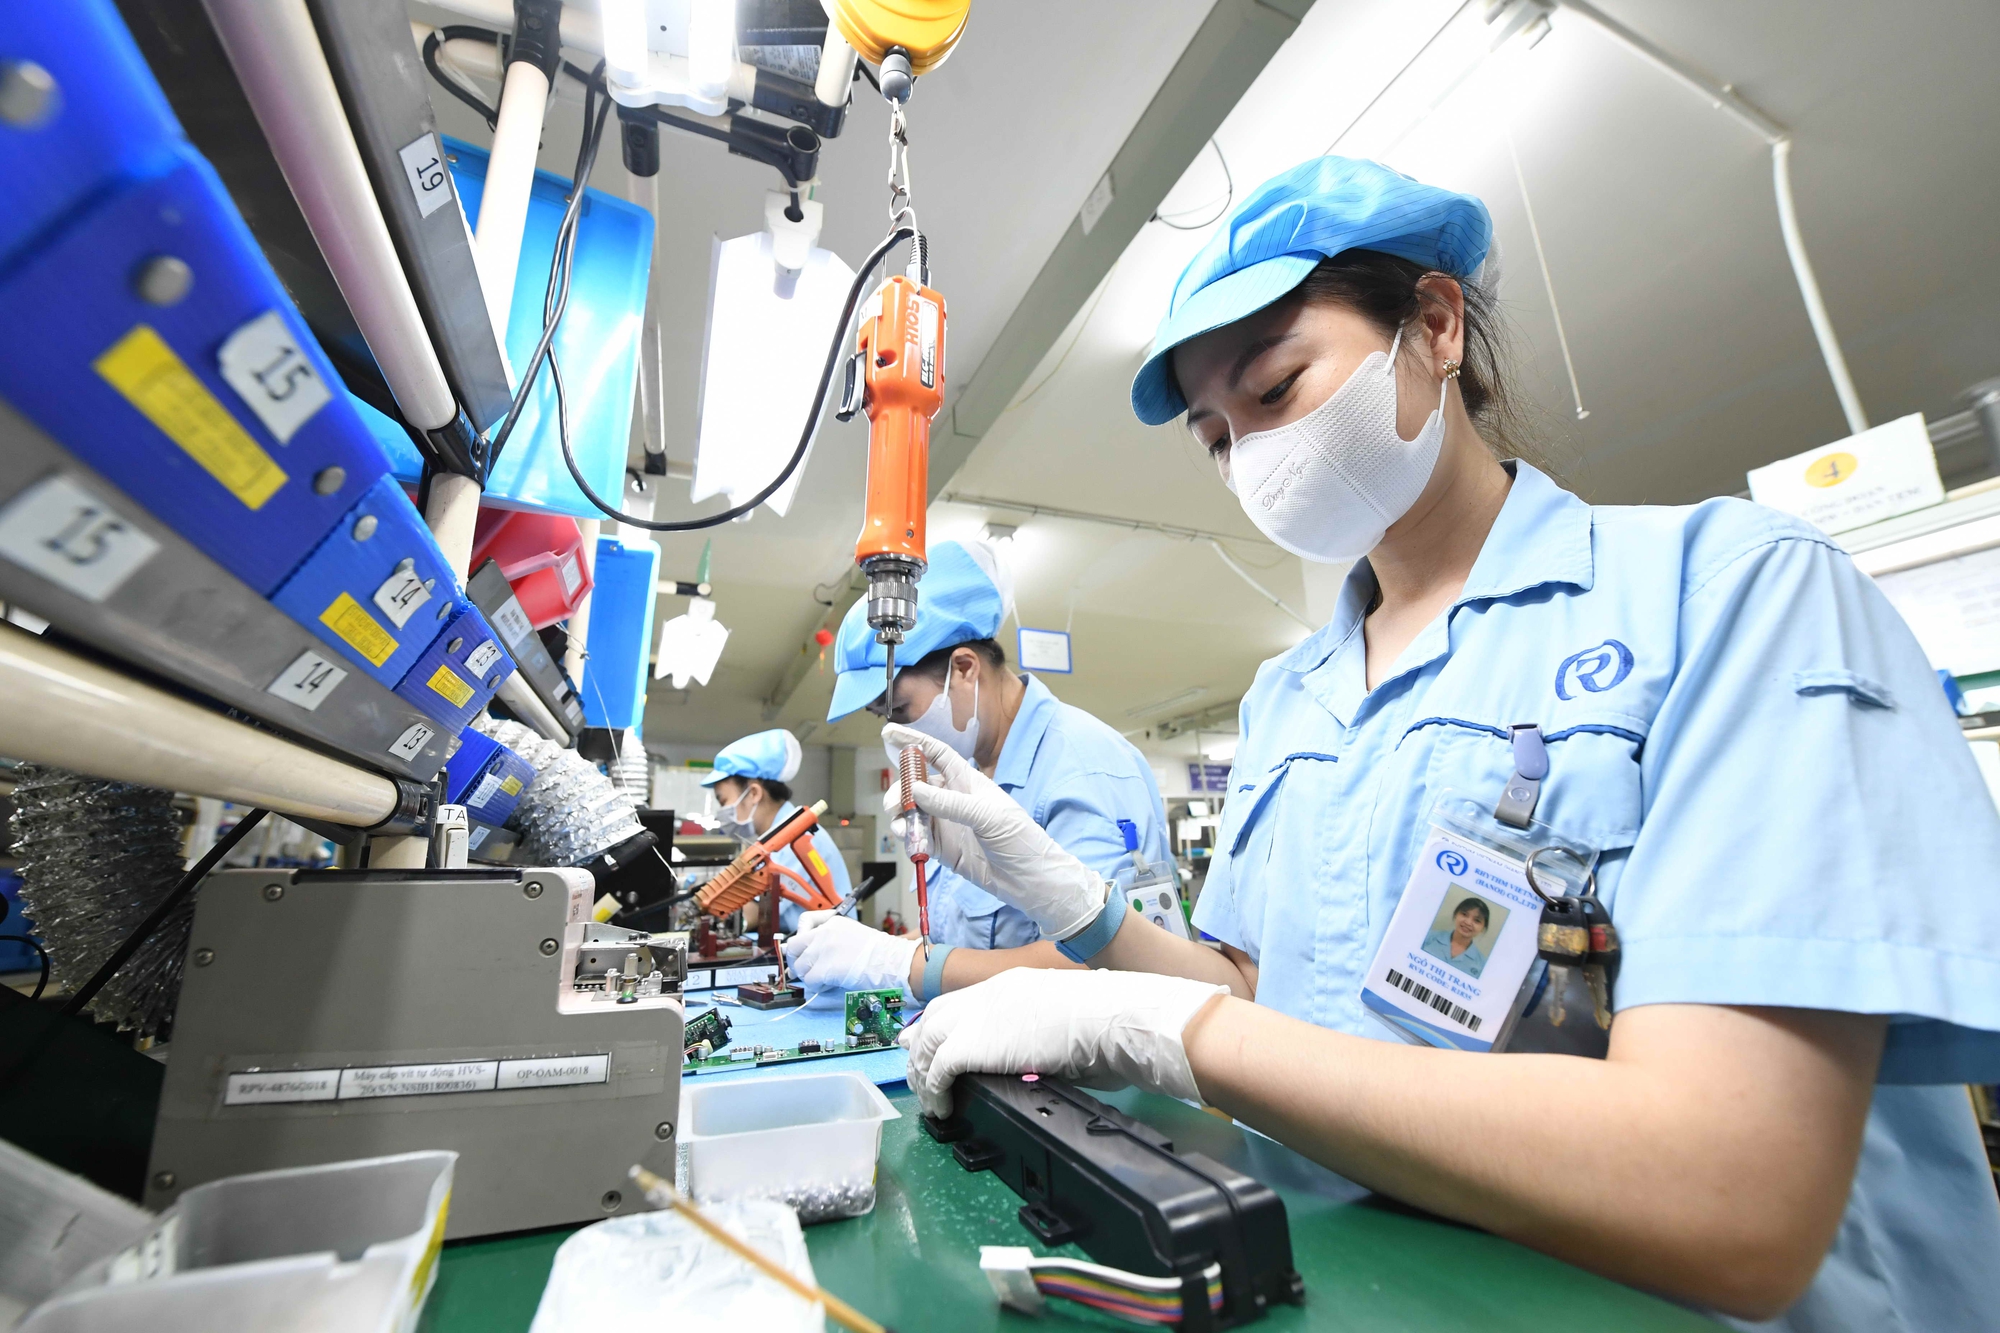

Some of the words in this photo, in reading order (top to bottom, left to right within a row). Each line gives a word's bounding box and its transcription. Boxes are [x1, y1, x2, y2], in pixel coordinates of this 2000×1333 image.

[416, 157, 444, 191] 19
[906, 299, 920, 346] HIOS
[251, 347, 311, 402] 15
[42, 506, 125, 565] 15
[391, 578, 421, 610] 14
[475, 645, 497, 667] 13
[294, 661, 334, 694] 14
[403, 727, 427, 750] 13
[1474, 867, 1508, 888] RHYTHM
[1475, 879, 1506, 896] (HANOI)
[1408, 952, 1428, 967] NGÔ
[1430, 963, 1447, 979] THỊ
[1447, 973, 1482, 996] TRANG
[1408, 962, 1425, 975] RVH
[1425, 971, 1449, 989] CODE:
[353, 1070, 376, 1083] Máy
[400, 1069, 415, 1079] vít
[416, 1068, 427, 1079] tự
[429, 1063, 454, 1079] động
[457, 1063, 486, 1076] HVS-
[516, 1066, 590, 1079] OP-OAM-0018
